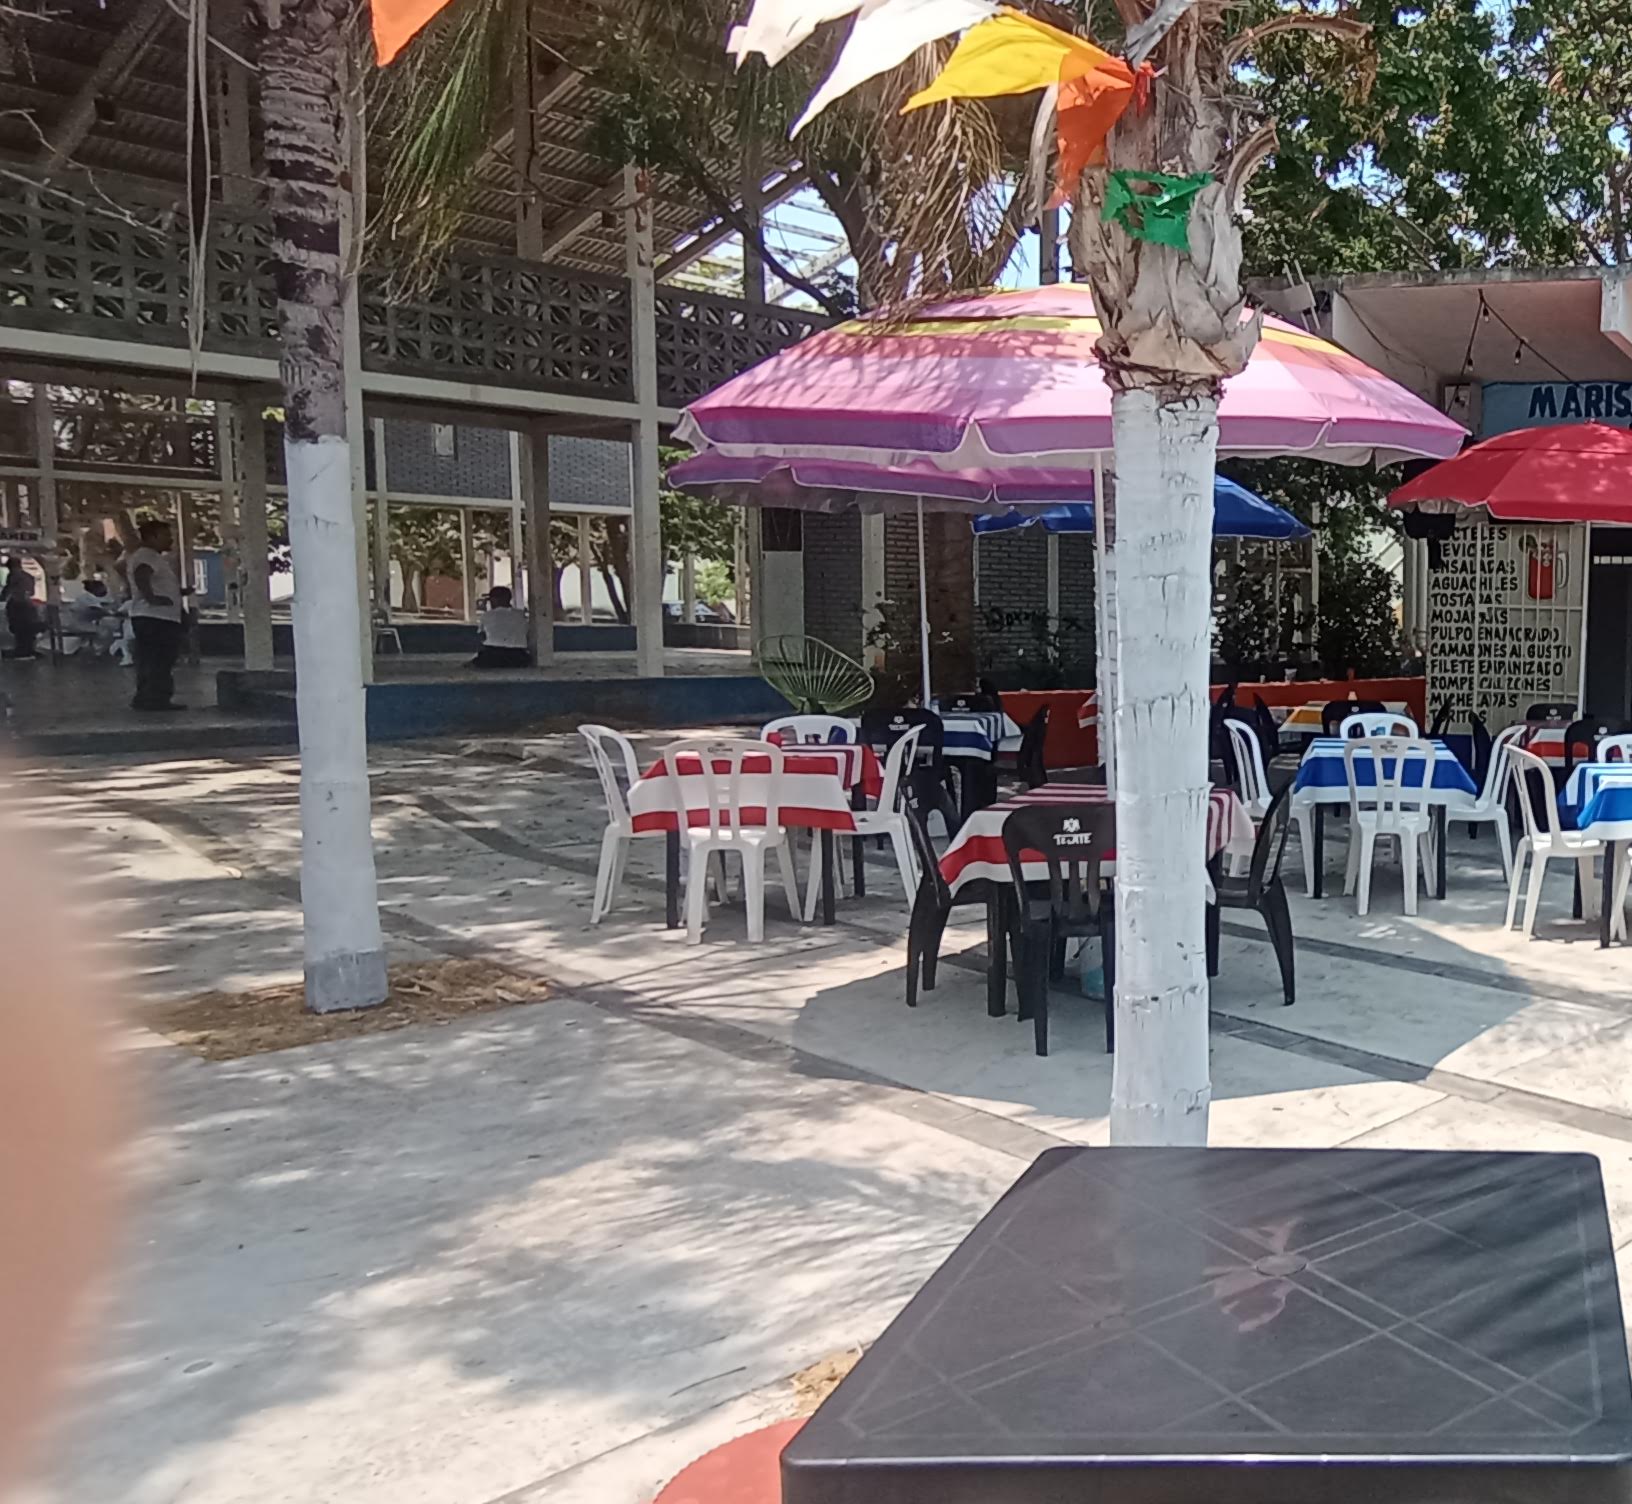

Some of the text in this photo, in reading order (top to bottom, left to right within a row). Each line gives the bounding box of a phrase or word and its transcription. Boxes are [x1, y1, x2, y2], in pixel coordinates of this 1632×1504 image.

[1430, 626, 1473, 641] PULPO
[1430, 659, 1475, 674] FILETE
[1430, 675, 1475, 691] ROMPE
[1053, 832, 1093, 846] TECATE
